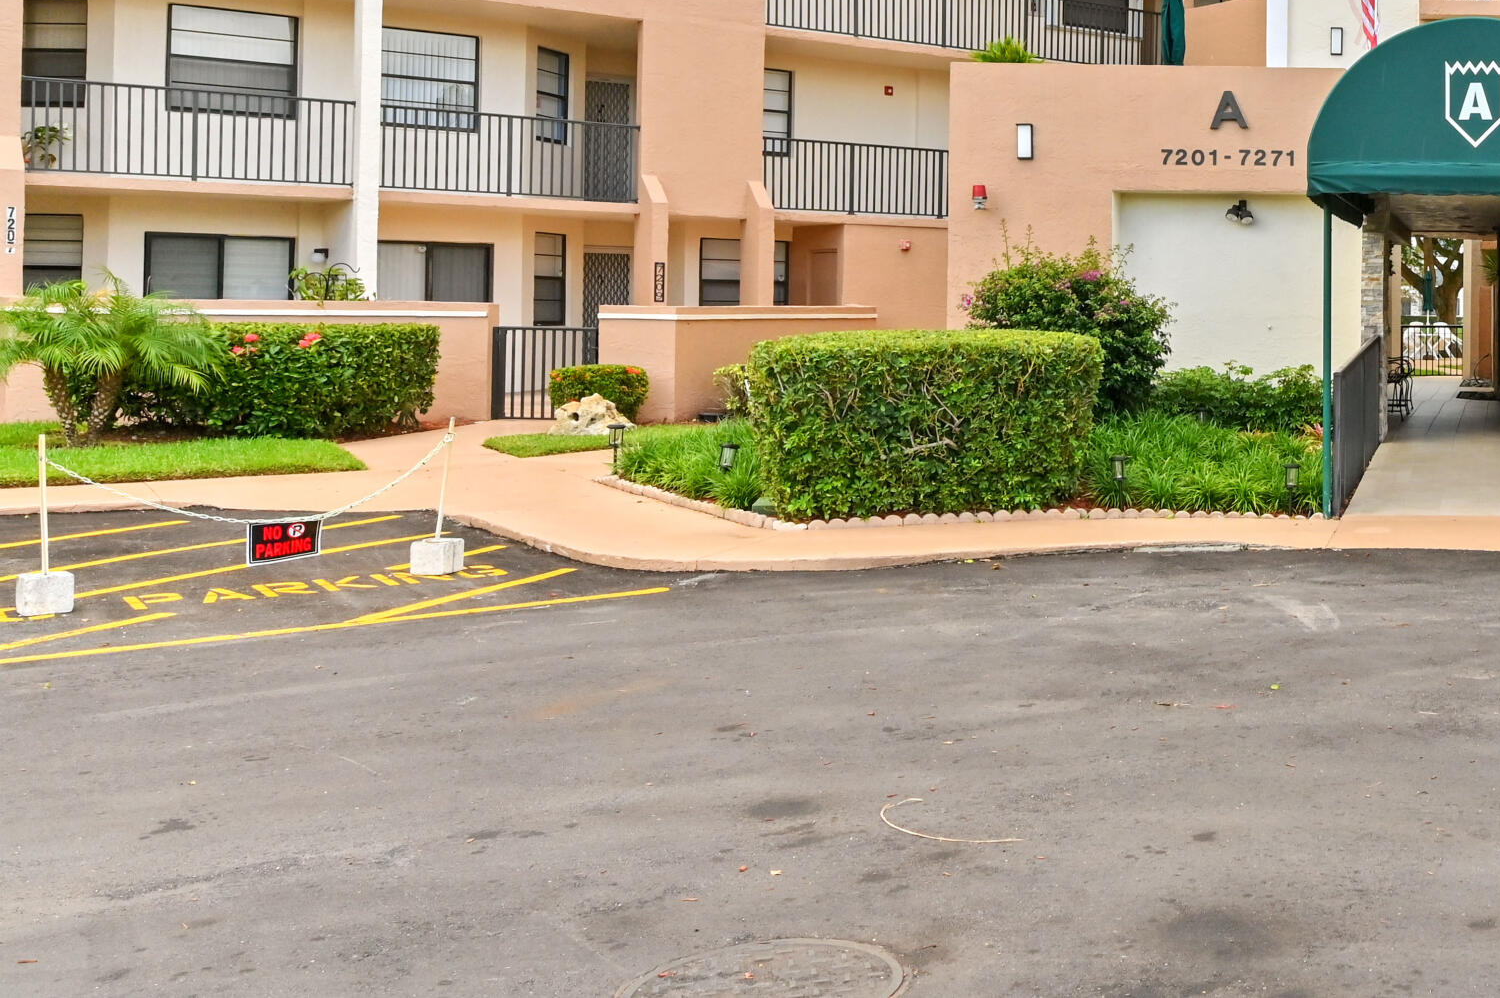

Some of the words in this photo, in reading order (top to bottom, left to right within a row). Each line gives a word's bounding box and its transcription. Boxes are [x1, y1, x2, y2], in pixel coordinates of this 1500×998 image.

[1210, 90, 1248, 130] A
[1458, 82, 1493, 120] A
[255, 537, 312, 559] PARKING
[263, 525, 283, 541] NO
